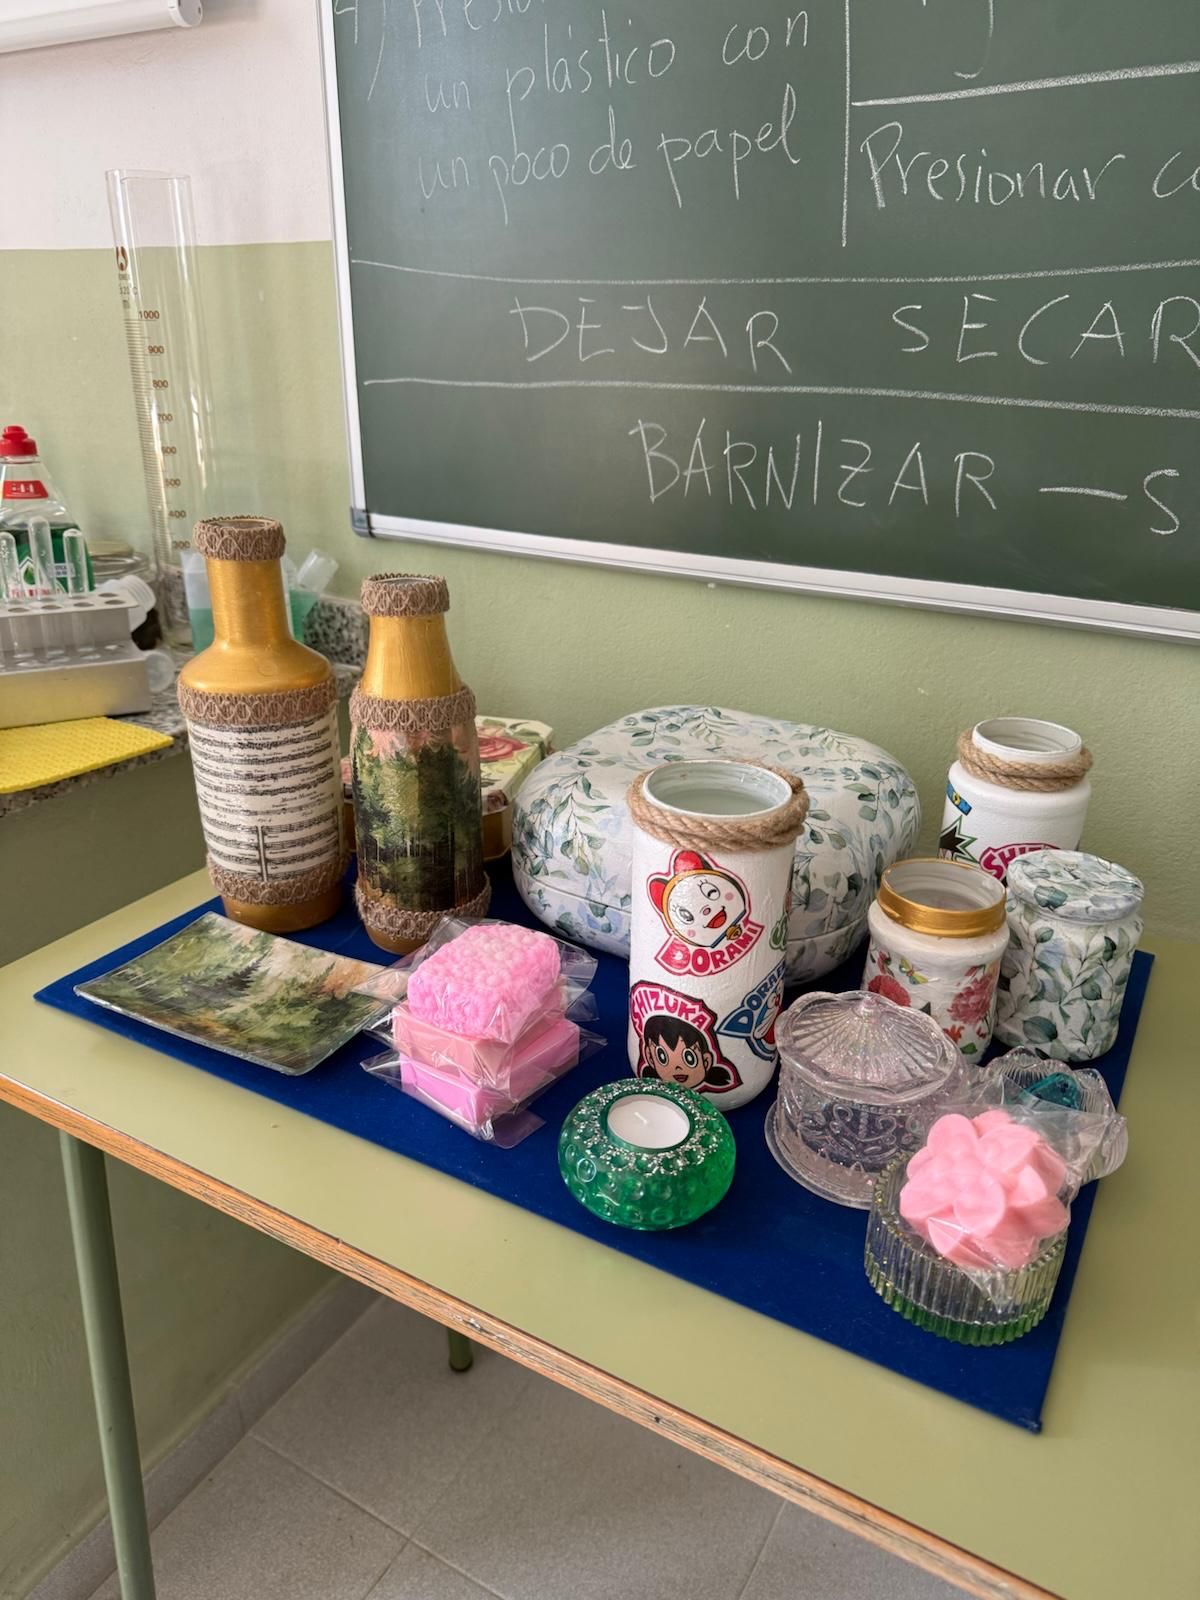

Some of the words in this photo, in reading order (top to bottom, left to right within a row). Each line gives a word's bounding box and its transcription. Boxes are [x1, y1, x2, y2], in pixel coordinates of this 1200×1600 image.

[424, 73, 471, 113] un
[505, 10, 676, 154] plástico
[722, 11, 809, 66] con
[418, 155, 471, 199] un
[488, 143, 571, 226] poco
[588, 104, 637, 175] de
[657, 83, 802, 208] papel
[860, 121, 1127, 210] Presionar
[138, 310, 160, 320] 1000
[147, 345, 165, 354] 900
[509, 294, 793, 375] DEJAR
[892, 293, 1200, 369] SECAR
[628, 417, 998, 518] BARNIZAR
[660, 924, 759, 971] DORAMI
[630, 988, 713, 1033] SHIZUKA
